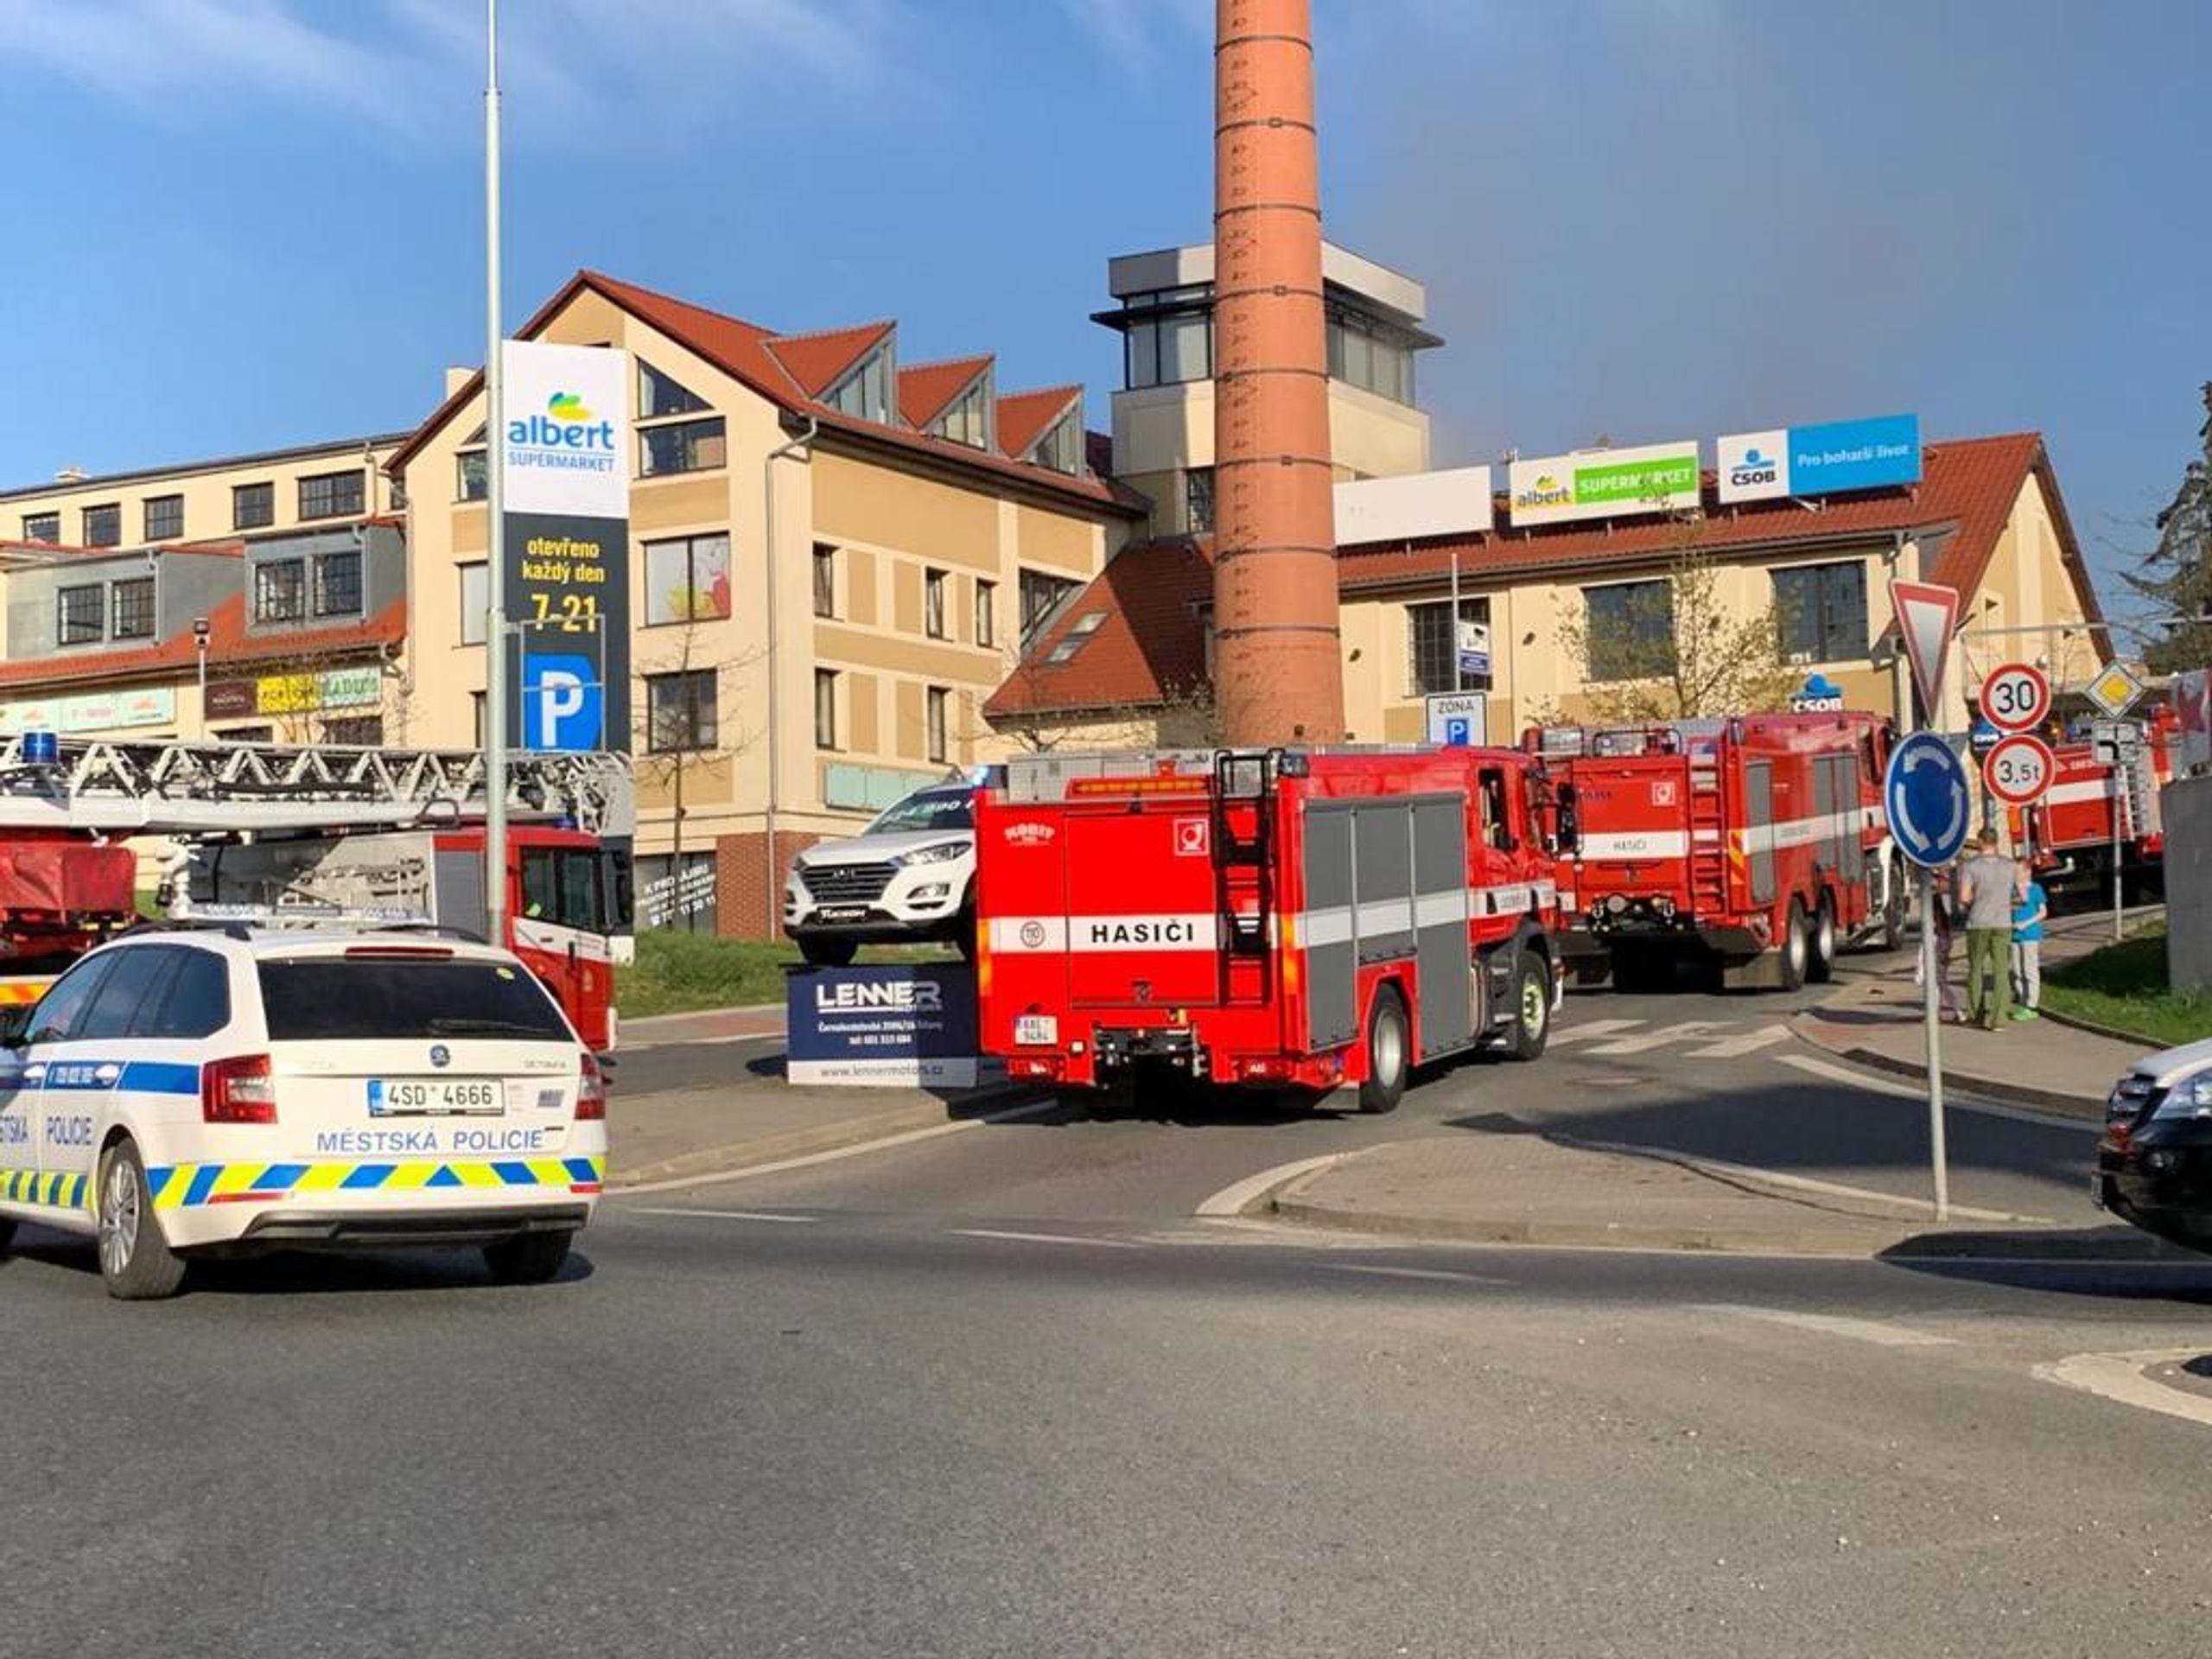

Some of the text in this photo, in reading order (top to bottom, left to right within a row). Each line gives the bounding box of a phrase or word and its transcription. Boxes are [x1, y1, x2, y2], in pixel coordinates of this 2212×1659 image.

[508, 415, 614, 450] albert
[508, 451, 614, 472] SUPERMARKET
[1518, 486, 1569, 507] albert
[527, 537, 600, 558] otevřeno
[522, 561, 604, 584] každý den
[541, 671, 584, 747] P
[1995, 679, 2035, 715] 30
[1450, 721, 1465, 744] P
[1091, 918, 1194, 944] HASIČI
[817, 981, 941, 1007] LENNER
[389, 1084, 493, 1106] 4SD 4666
[316, 1127, 543, 1152] MĚSTSKÁ POLICIE
